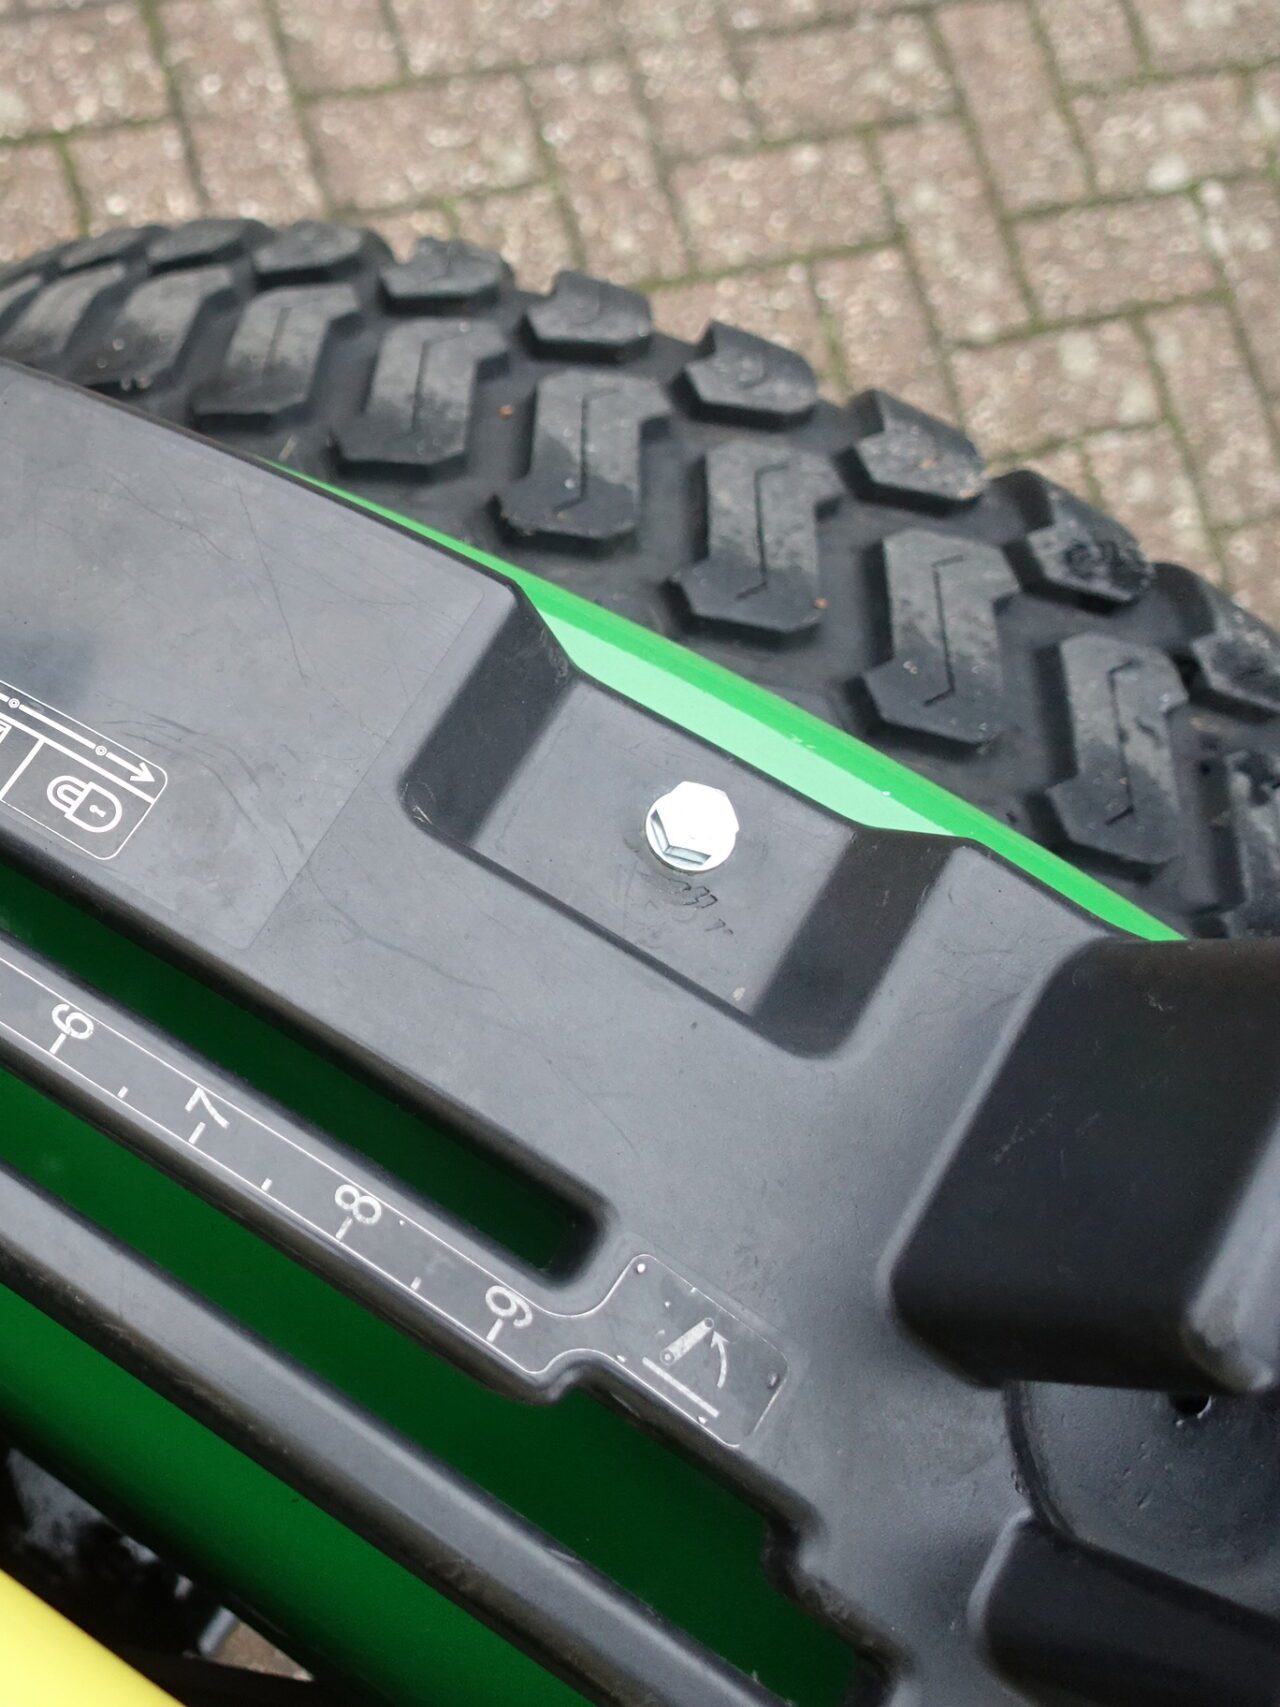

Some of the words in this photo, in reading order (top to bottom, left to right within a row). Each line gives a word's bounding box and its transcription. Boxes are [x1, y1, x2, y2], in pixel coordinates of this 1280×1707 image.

[51, 1003, 95, 1040] 6
[185, 1087, 230, 1129] 7
[334, 1184, 382, 1225] 8
[485, 1285, 532, 1327] 9
